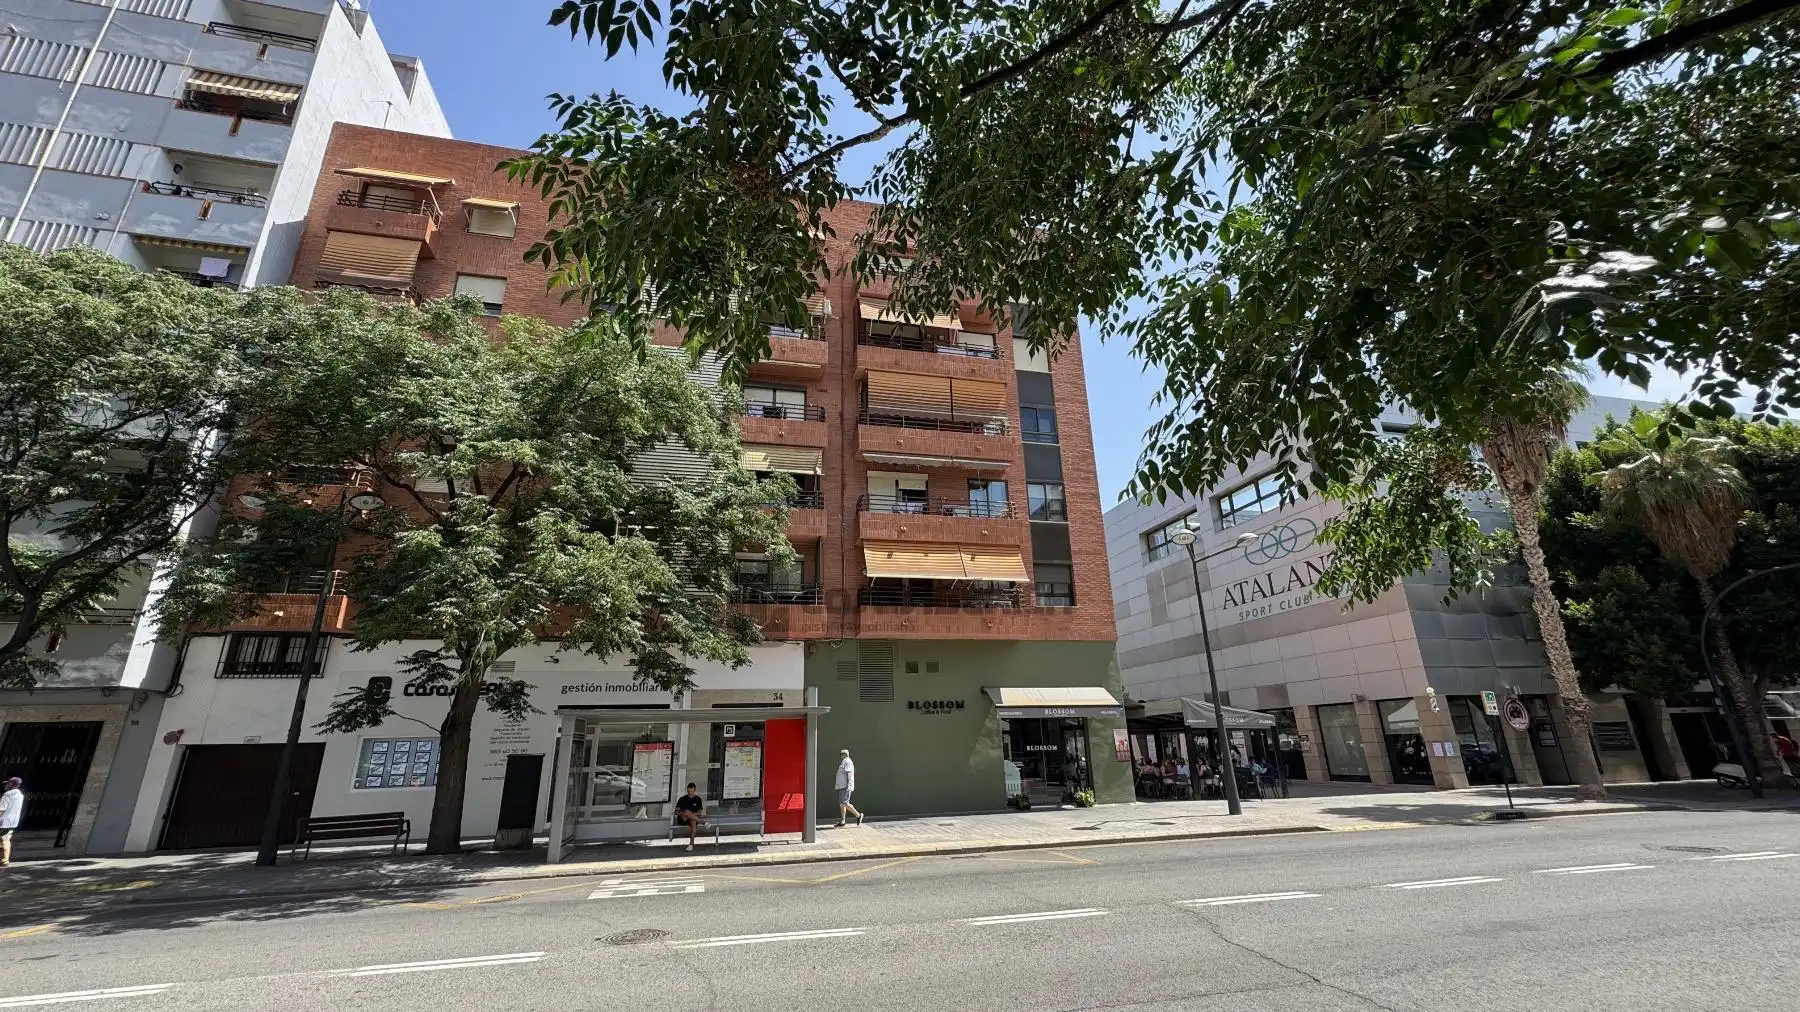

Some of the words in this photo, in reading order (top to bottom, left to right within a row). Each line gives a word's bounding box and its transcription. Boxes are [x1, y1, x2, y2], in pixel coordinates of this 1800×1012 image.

[1223, 551, 1335, 610] ATALAN
[1239, 604, 1273, 622] SPORT
[1279, 594, 1311, 611] CLUB
[561, 682, 602, 694] gestión
[773, 692, 784, 701] 34
[907, 700, 965, 710] BLOSSOM
[1044, 708, 1076, 716] BLOSSOM
